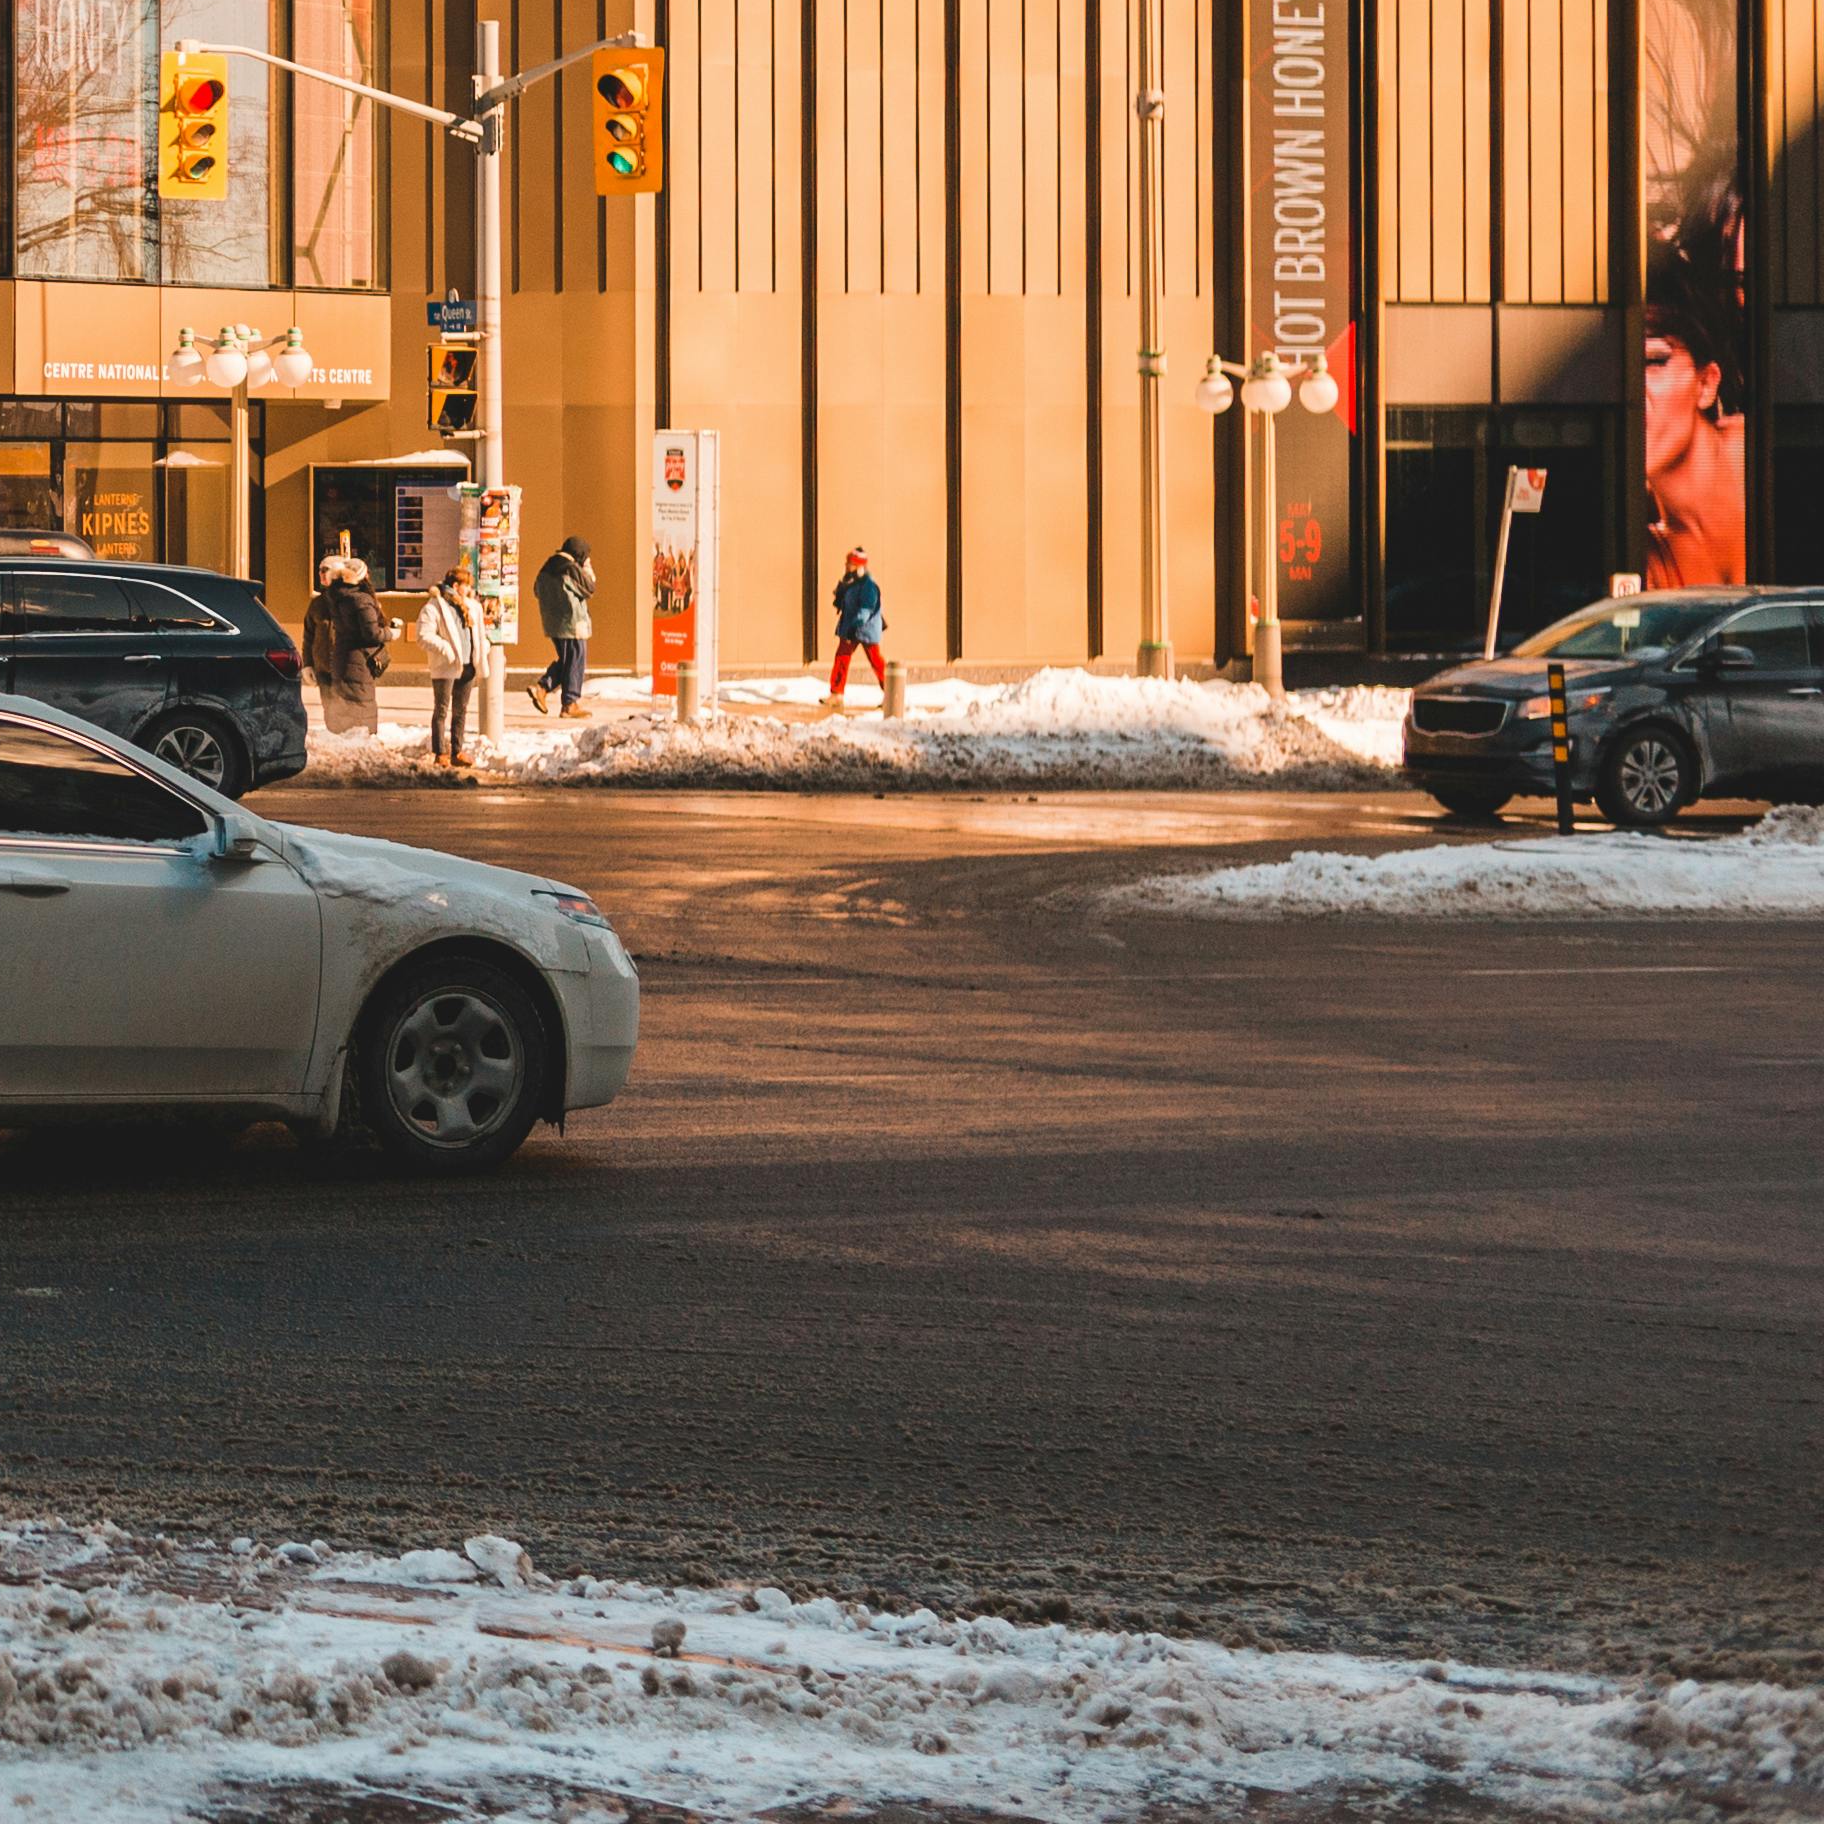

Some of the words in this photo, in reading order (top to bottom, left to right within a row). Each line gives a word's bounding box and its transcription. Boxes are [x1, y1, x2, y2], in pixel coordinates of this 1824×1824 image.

[1273, 129, 1326, 281] BROWN
[43, 362, 94, 379] CENTRE
[98, 363, 161, 381] NATIONAL
[329, 368, 373, 385] CENTRE
[82, 512, 150, 536] KIPNES
[96, 542, 137, 556] LANTERN
[1279, 518, 1322, 564] 5-9
[1289, 566, 1313, 581] MAI
